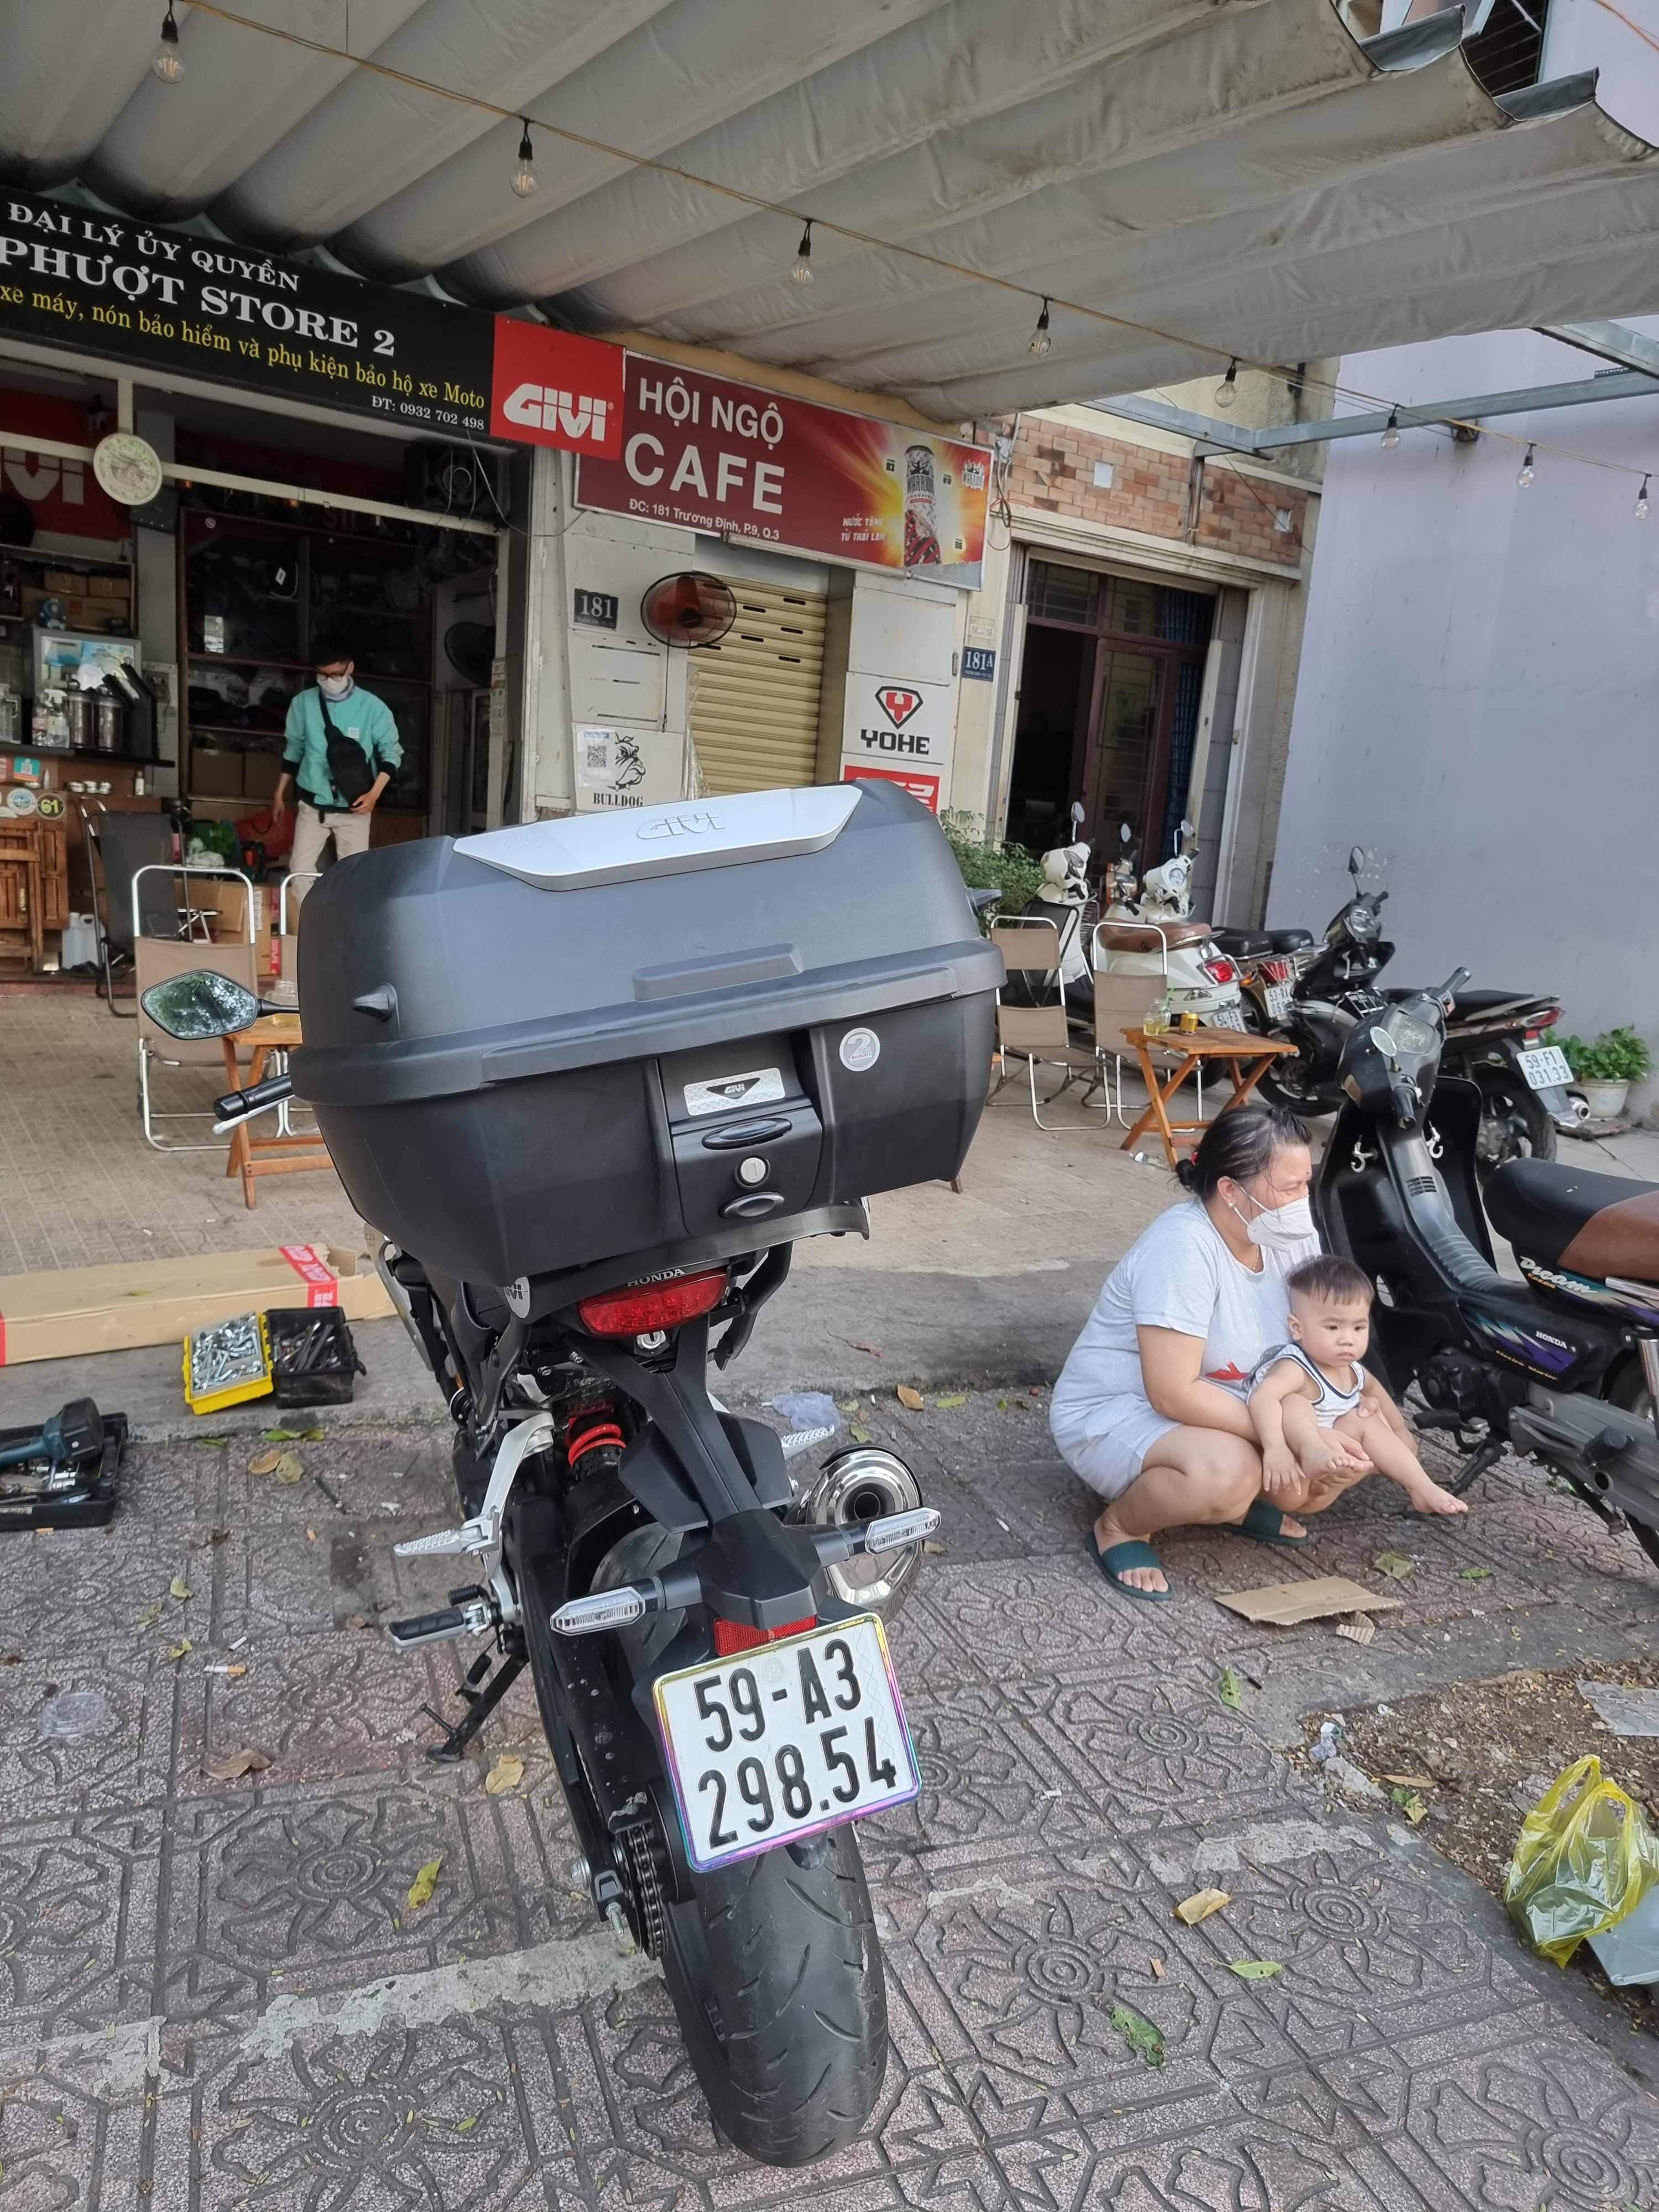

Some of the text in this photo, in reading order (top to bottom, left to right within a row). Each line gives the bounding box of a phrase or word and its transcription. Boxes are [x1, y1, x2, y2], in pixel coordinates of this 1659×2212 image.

[8, 202, 300, 292] ĐẠI LÝ ỦY QUYỀN
[0, 236, 396, 357] PHƯỢT STORE 2
[0, 286, 485, 409] xe máy, nón bảo hiểm và phụ kiện bảo hộ xe Moto
[371, 396, 484, 430] ĐT: 0932 702 498
[503, 383, 607, 442] GIVI
[639, 377, 784, 451] HỘI NGỘ
[625, 433, 785, 515] CAFE
[629, 499, 649, 513] ĐC:
[653, 504, 670, 517] 181
[673, 507, 713, 528] Trương
[715, 517, 741, 533] Định,
[763, 527, 780, 540] Q.3
[580, 594, 613, 619] 181
[965, 651, 993, 670] 181A
[860, 729, 930, 755] YOHE
[41, 798, 59, 814] 61
[593, 792, 644, 807] BULLDOG
[1525, 1051, 1558, 1069] 59-F1
[1528, 1066, 1569, 1085] 031.33
[724, 1083, 745, 1094] GIVI
[627, 1268, 686, 1287] HONDA
[1520, 1255, 1598, 1294] Dream
[1535, 1330, 1568, 1349] HONDA
[693, 1638, 862, 1753] 59-A3
[697, 1717, 898, 1850] 298.54
